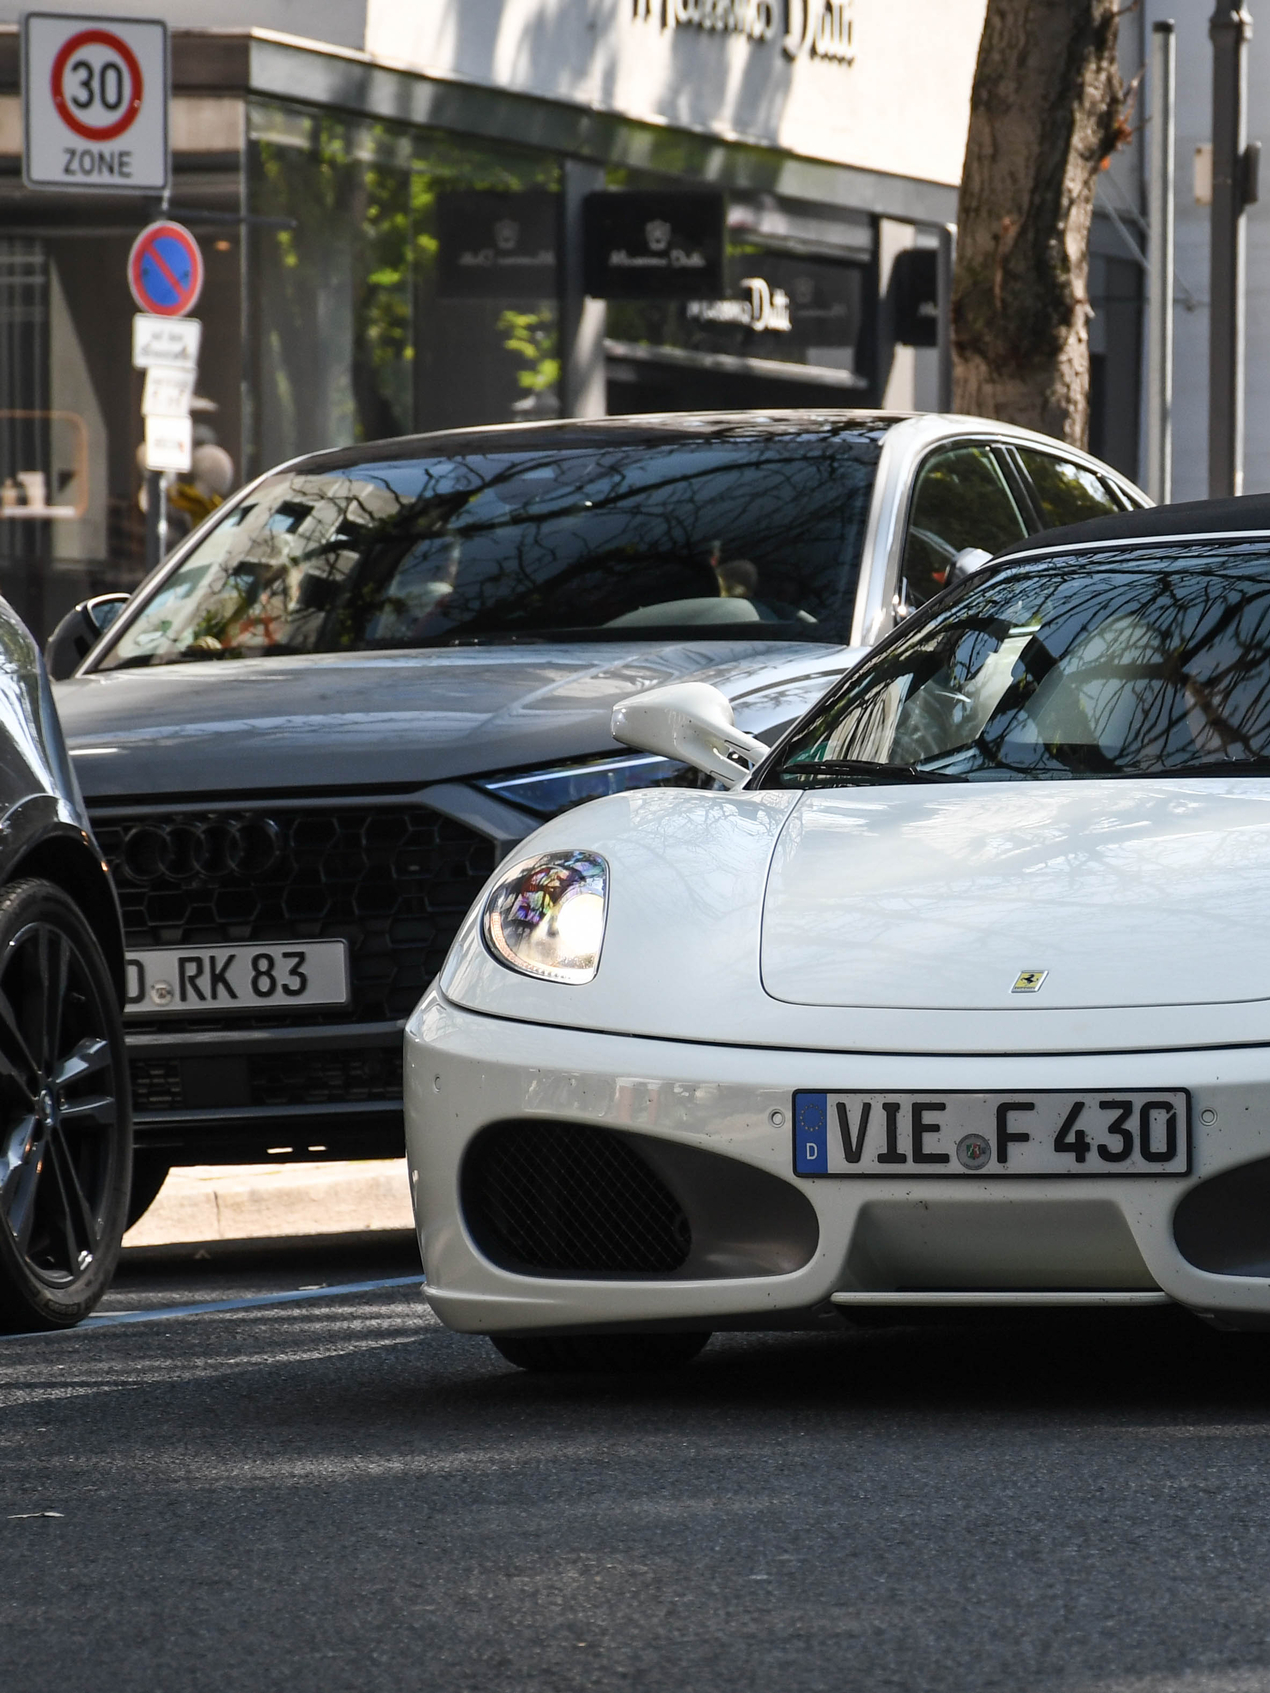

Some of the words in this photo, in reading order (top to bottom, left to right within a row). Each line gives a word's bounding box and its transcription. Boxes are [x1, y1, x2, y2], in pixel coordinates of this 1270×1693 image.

[71, 60, 124, 111] 30
[63, 148, 133, 178] ZONE
[178, 954, 239, 1002] RK
[251, 951, 308, 998] 83
[806, 1143, 817, 1160] D
[836, 1101, 950, 1164] VIE
[996, 1102, 1035, 1163] F
[1054, 1101, 1177, 1163] 430
